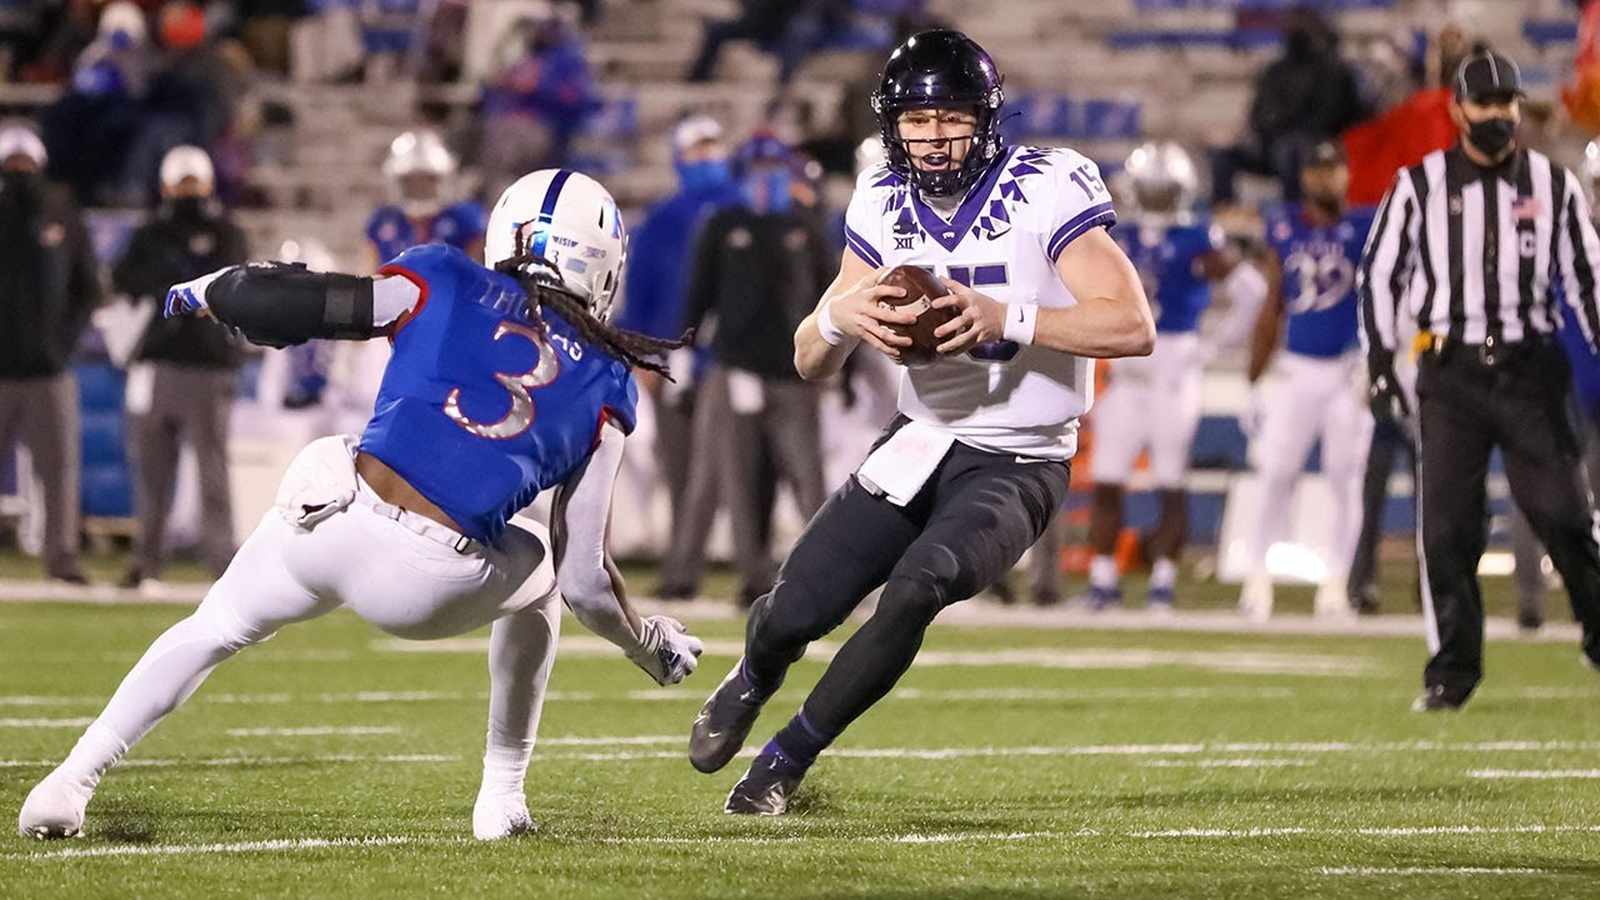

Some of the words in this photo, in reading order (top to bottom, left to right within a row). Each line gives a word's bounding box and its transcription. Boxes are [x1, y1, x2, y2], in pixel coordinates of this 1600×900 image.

[1069, 162, 1105, 201] 15
[893, 236, 914, 250] XII
[444, 320, 560, 440] 3
